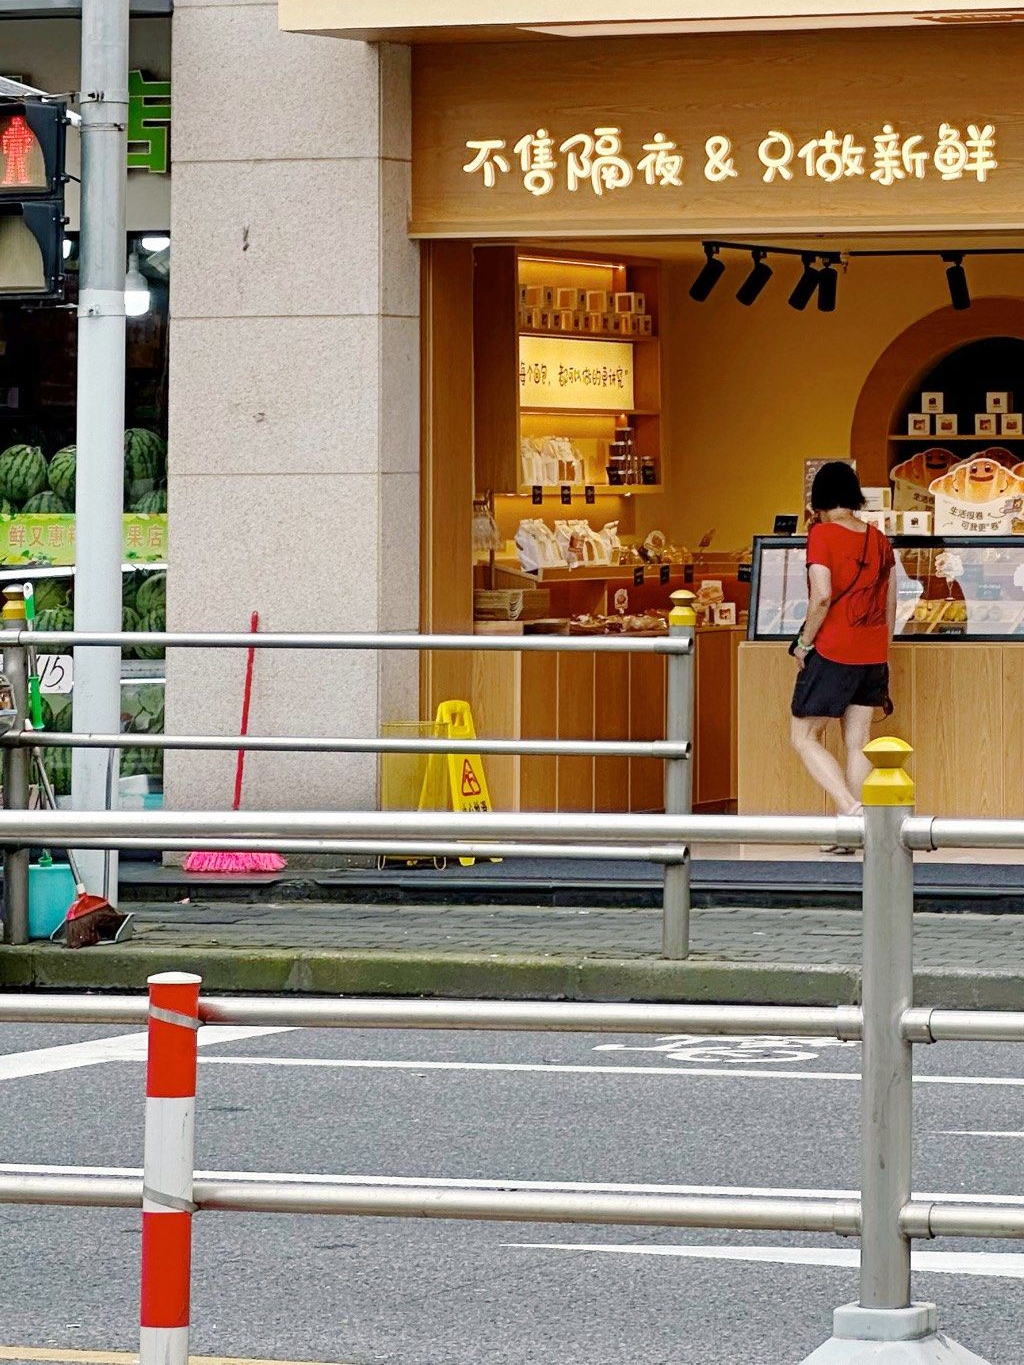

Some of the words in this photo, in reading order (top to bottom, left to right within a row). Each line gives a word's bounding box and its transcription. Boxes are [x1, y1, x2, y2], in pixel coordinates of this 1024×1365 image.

[704, 135, 738, 182] &
[757, 123, 998, 186] 只做新鲜
